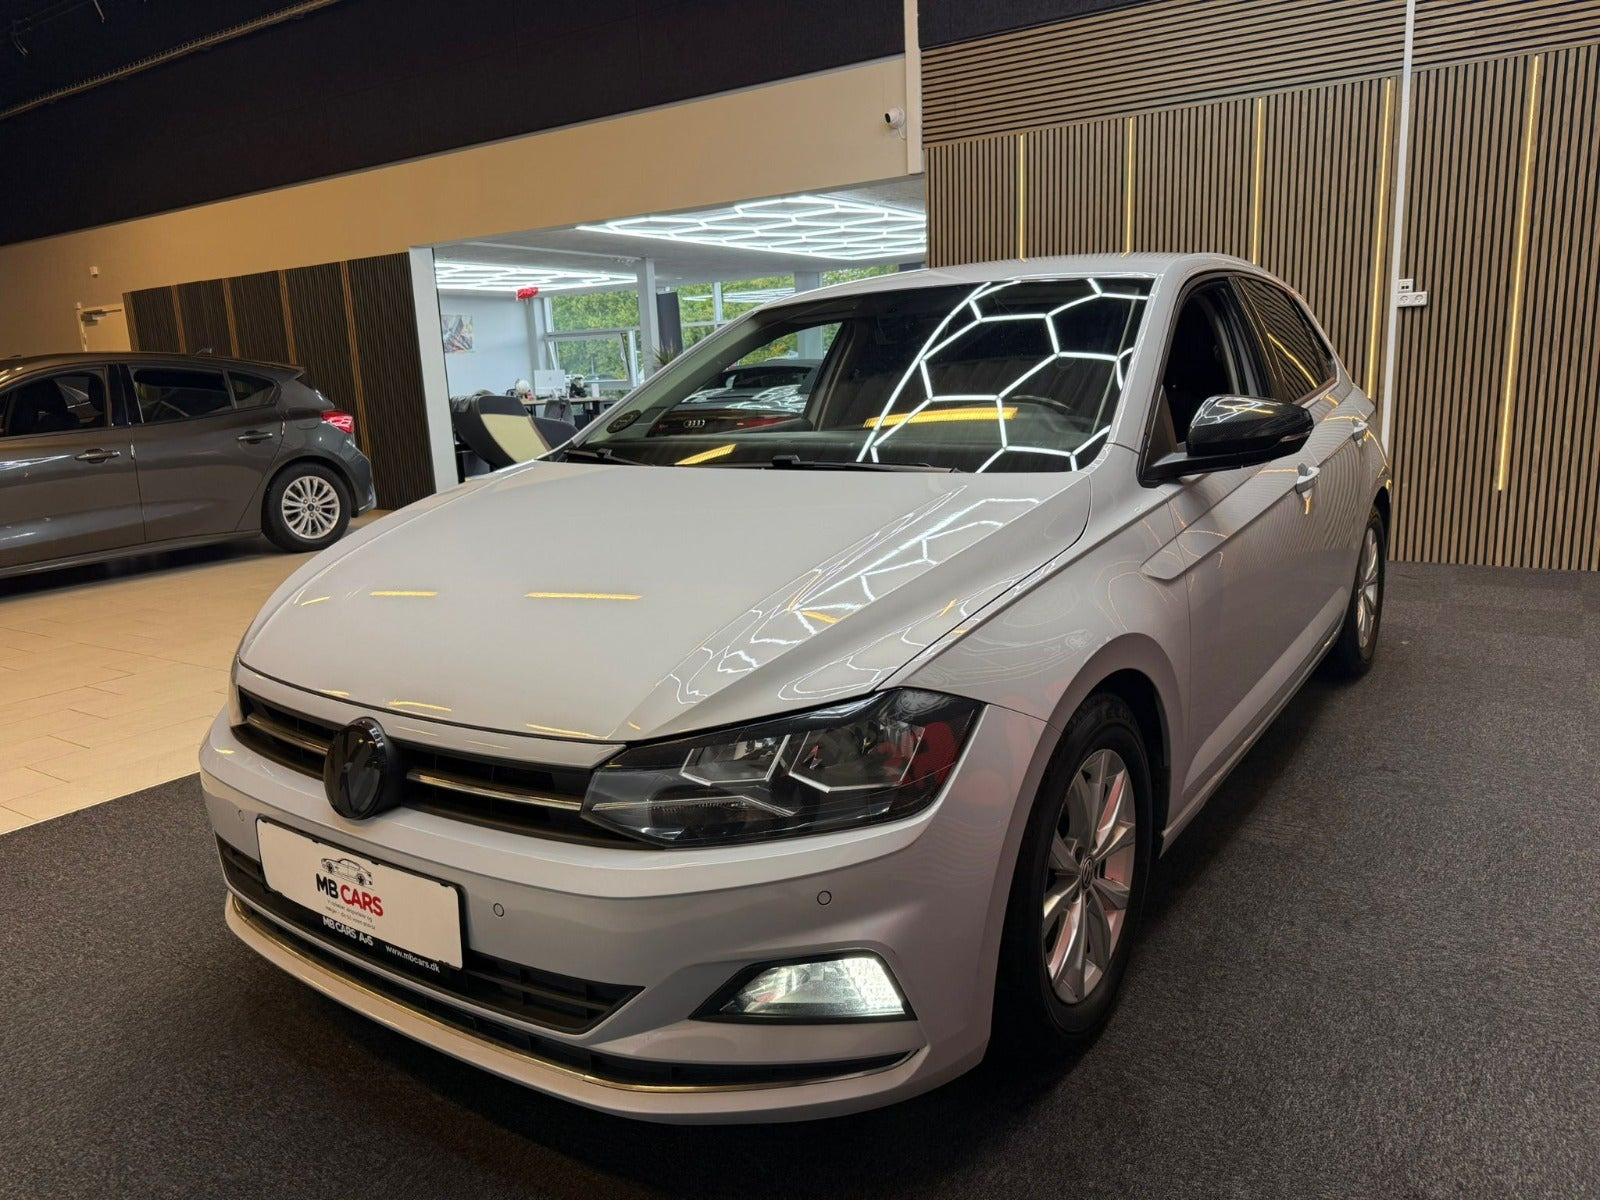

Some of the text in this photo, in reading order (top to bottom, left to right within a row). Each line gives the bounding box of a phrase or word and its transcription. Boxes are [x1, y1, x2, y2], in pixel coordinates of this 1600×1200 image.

[316, 873, 338, 899] MB
[340, 884, 383, 917] CARS
[335, 922, 357, 939] CARS
[385, 945, 440, 973] www.mbcars.dk
